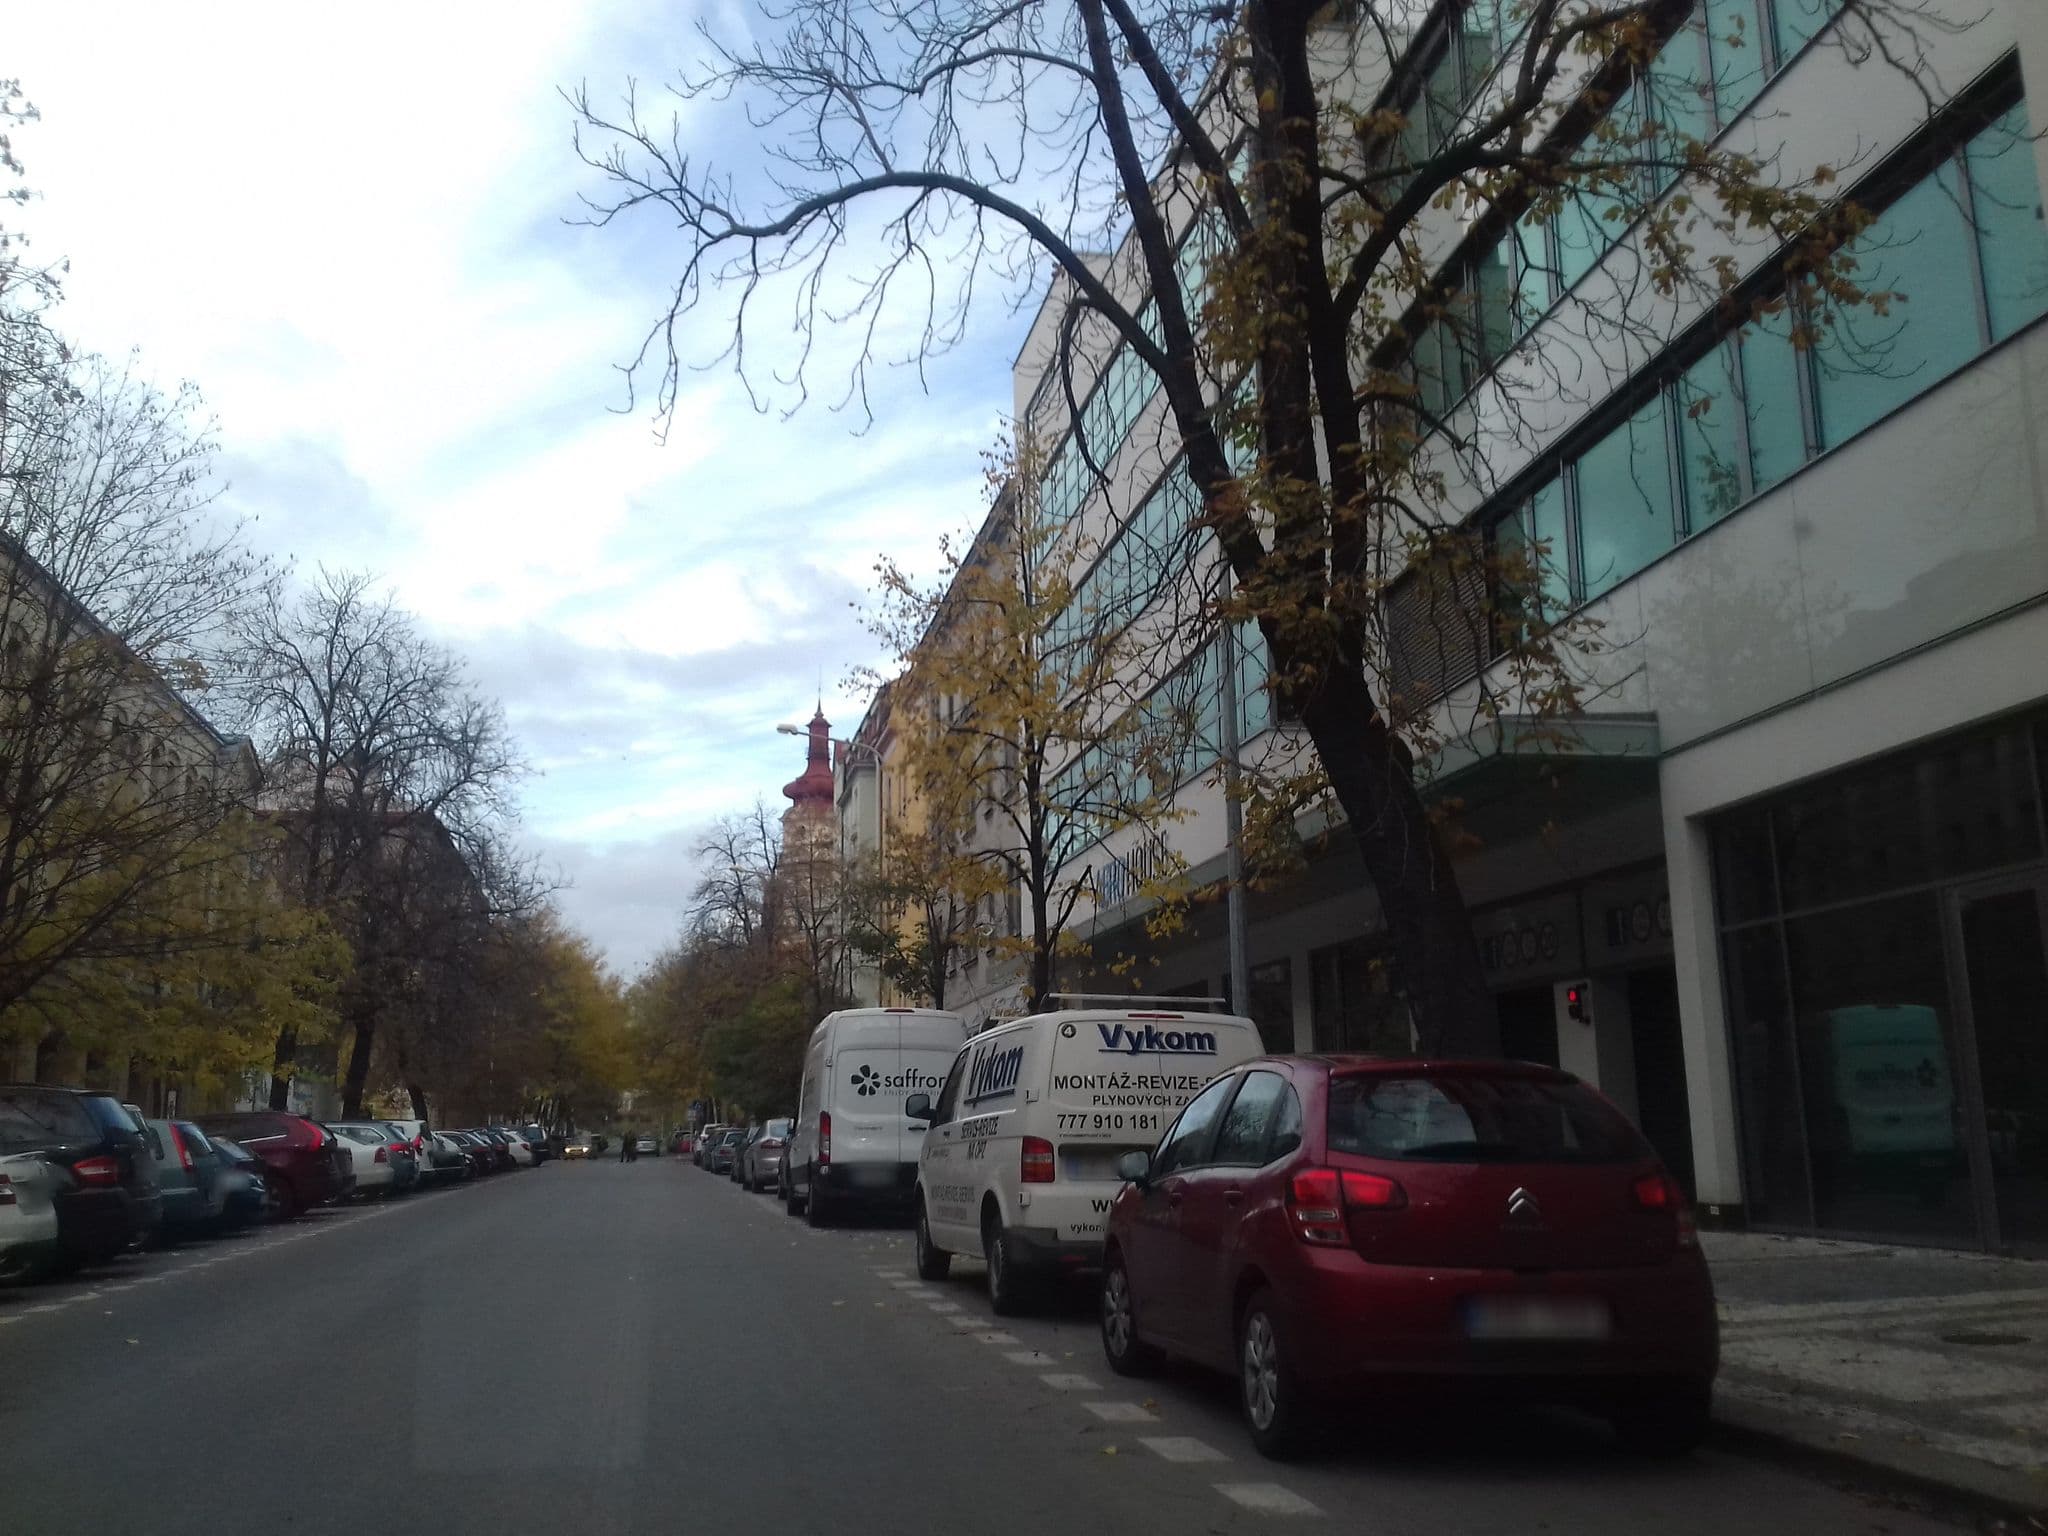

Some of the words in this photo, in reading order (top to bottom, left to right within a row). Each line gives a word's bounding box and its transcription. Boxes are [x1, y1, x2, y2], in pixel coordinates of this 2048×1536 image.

[1097, 1023, 1216, 1056] Vykom
[968, 1041, 1023, 1105] Vykom
[1093, 1093, 1171, 1106] PLYNOVÝCH
[1057, 1114, 1088, 1129] 777
[1093, 1114, 1123, 1129] 910
[1130, 1114, 1157, 1129] 181
